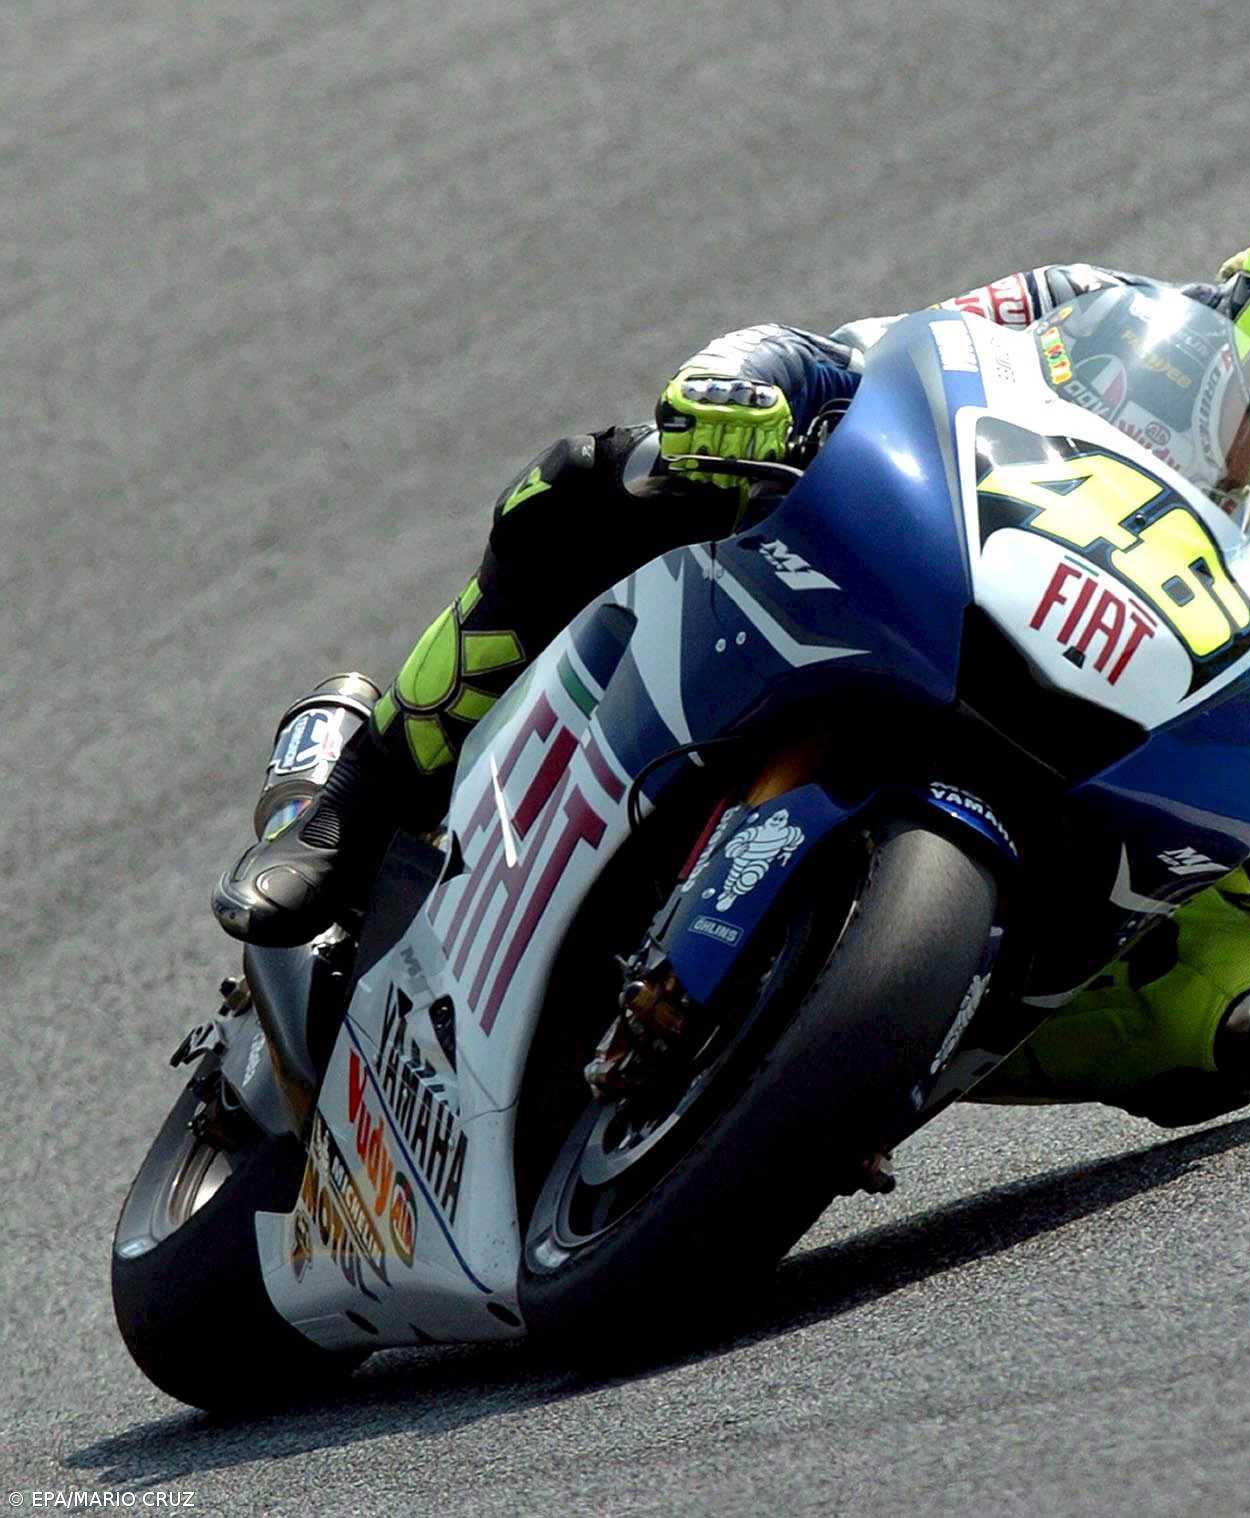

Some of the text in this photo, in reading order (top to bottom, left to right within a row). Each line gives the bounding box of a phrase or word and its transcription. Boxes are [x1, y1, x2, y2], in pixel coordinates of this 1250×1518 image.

[976, 454, 1250, 658] 46
[1028, 562, 1155, 686] FIAT
[428, 690, 608, 1037] FIAT
